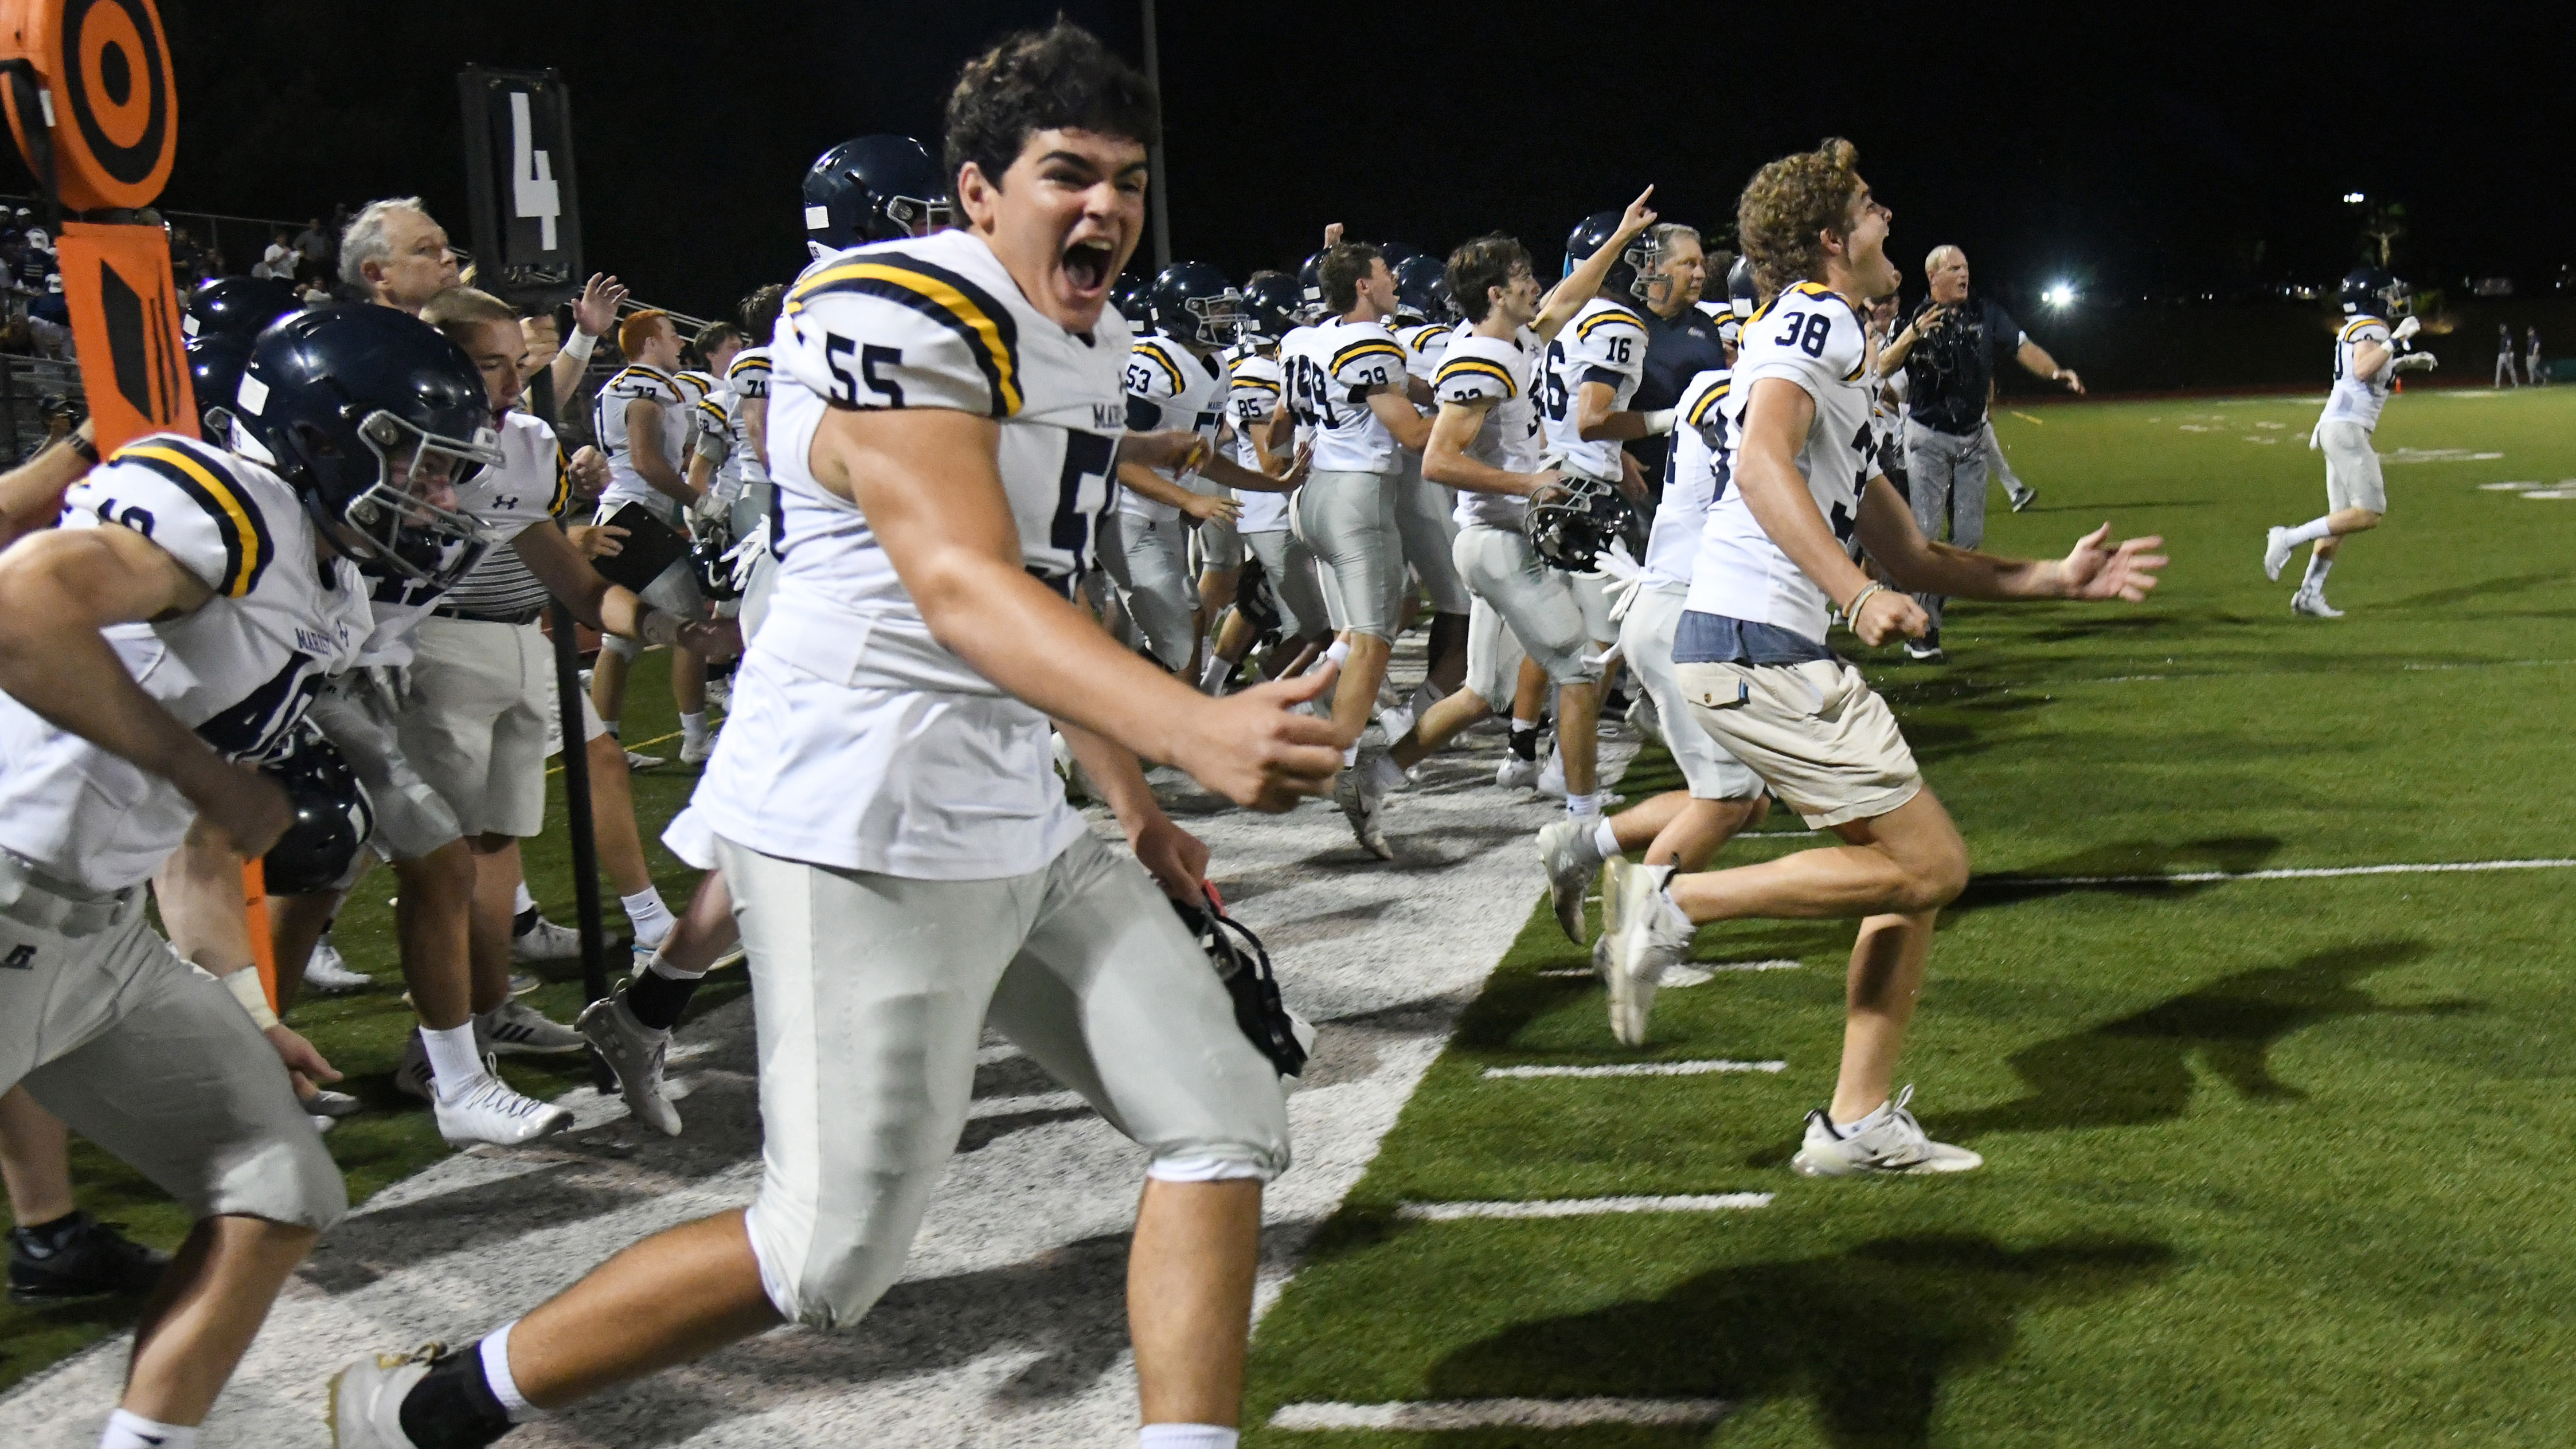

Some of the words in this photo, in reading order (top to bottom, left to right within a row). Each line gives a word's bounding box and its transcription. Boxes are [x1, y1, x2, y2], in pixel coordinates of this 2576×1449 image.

[510, 92, 561, 251] 4
[1605, 336, 1632, 363] 16
[1774, 311, 1831, 358] 38
[826, 331, 904, 410] 55
[1126, 363, 1151, 393] 53
[1237, 398, 1262, 418] 85
